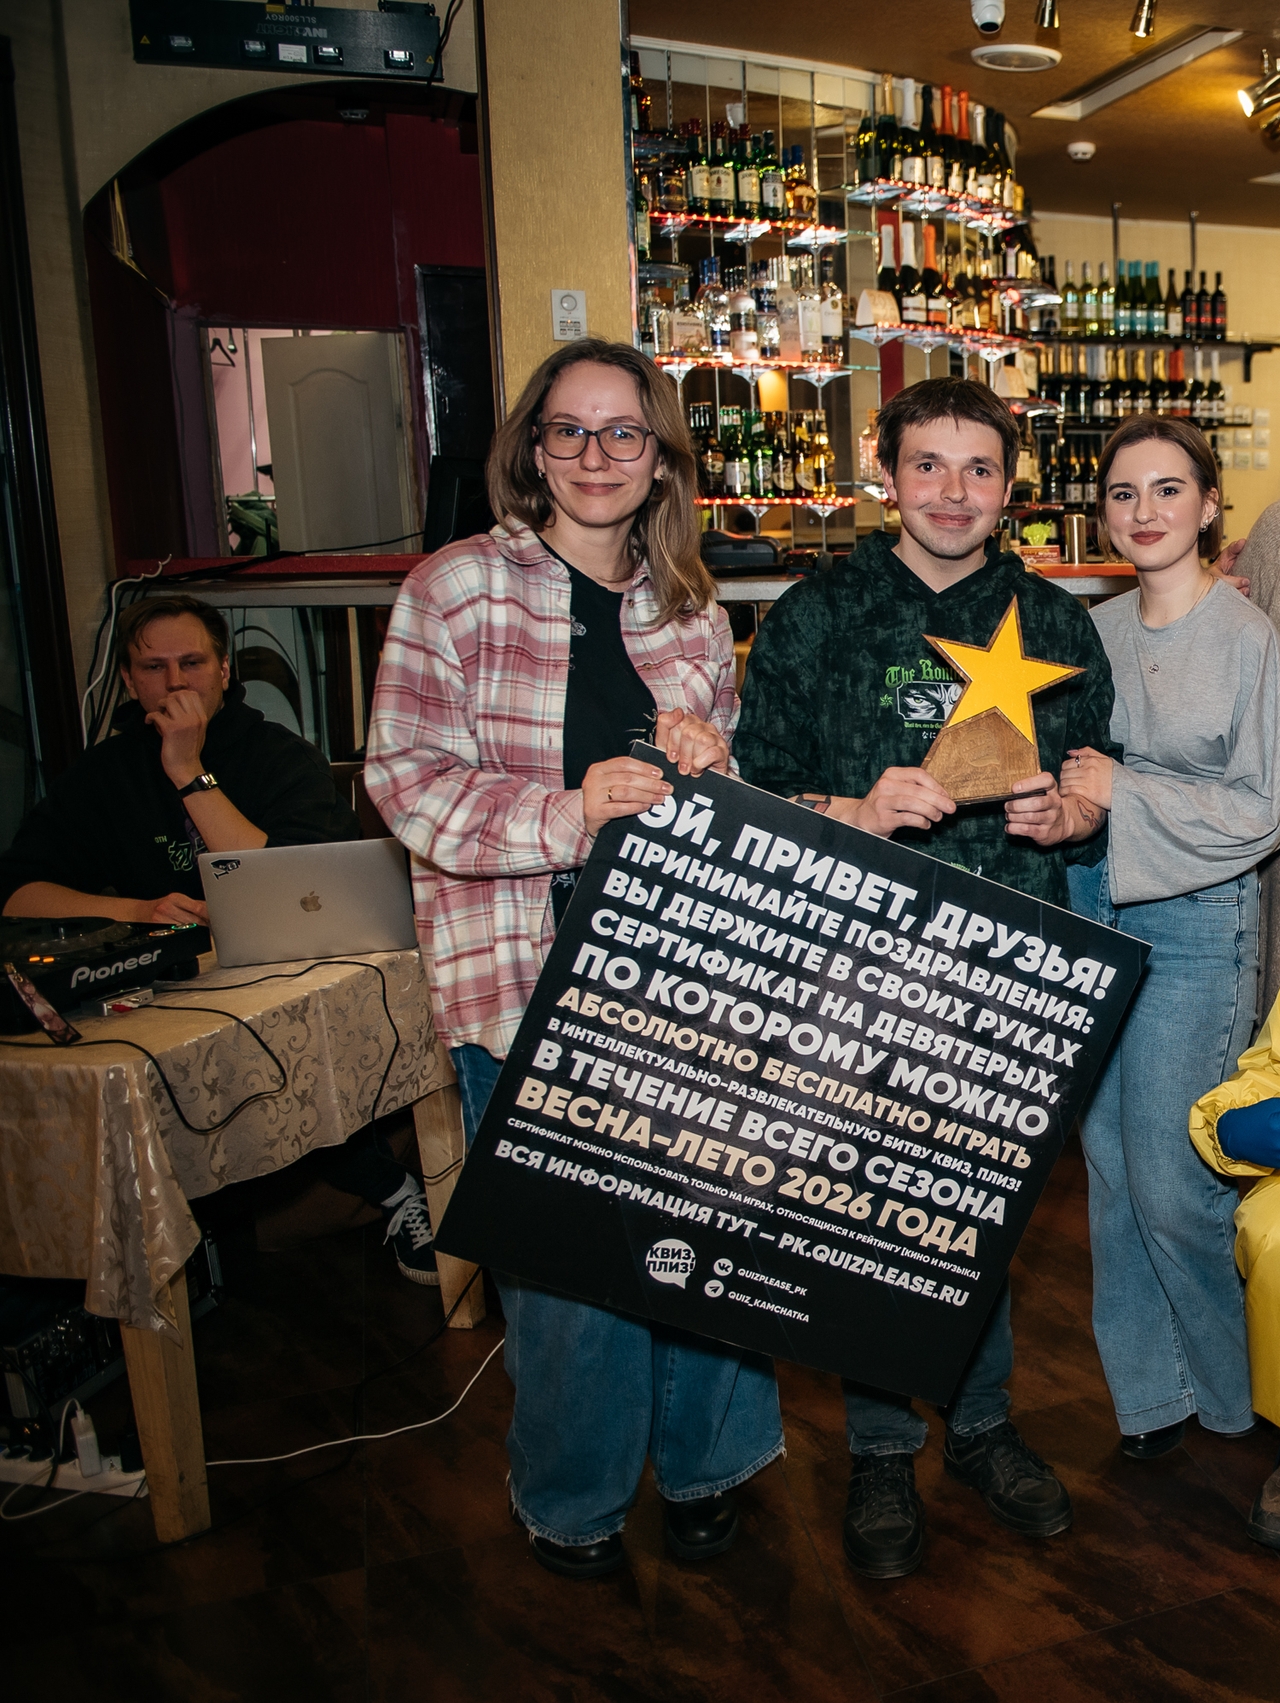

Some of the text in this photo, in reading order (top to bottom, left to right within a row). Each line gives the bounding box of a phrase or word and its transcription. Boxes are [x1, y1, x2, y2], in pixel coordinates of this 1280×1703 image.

[71, 949, 162, 989] Pioneer
[602, 868, 1083, 1068] ВЫ ДЕРЖИТЕ В СВОИХ РУКАХ
[618, 833, 1094, 1034] ПРИНИМАЙТЕ ПОЗДРАВЛЕНИЯ:
[635, 793, 1117, 1000] ЭЙ, ПРИВЕТ, ДРУЗЬЯ!
[556, 986, 1031, 1169] АБСОЛЮТНО БЕСПЛАТНО ИГРАТЬ
[572, 942, 1049, 1136] ПО КОТОРОМУ МОЖНО
[591, 909, 1060, 1104] СЕРТИФИКАТ НА ДЕВЯТЕРЫХ,
[515, 1077, 977, 1257] ВЕСНА-ЛЕТО 2026 ГОДА
[532, 1039, 1005, 1225] В ТЕЧЕНИЕ ВСЕГО СЕЗОНА
[547, 1017, 1022, 1192] В ИНТЕЛЛЕКТУАЛЬНО-РАЗВЛЕКАТЕЛЬНУЮ БИТВУ КВИЗ, ПЛИЗ!
[495, 1140, 545, 1169] ВСЯ
[545, 1156, 714, 1224] ИНФОРМАЦИЯ
[716, 1211, 758, 1237] ТУТ
[778, 1233, 969, 1306] PK.QUIZPLEASE.RU
[507, 1117, 981, 1281] СЕРТИФИКАТ МОЖНО ИСПОЛЬЗОВАТЬ ТОЛЬКО НА ИГРАХ, ОТНОСЯЩИХСЯ К РЕЙТИНГУ [КИНО И МУЗЫКА]
[648, 1260, 694, 1273] ПЛИЗ!
[649, 1247, 695, 1262] КВИЗ,
[737, 1268, 808, 1296] QUIZPLEASE_PK
[728, 1291, 809, 1322] QUIZ_KAMCHATKA
